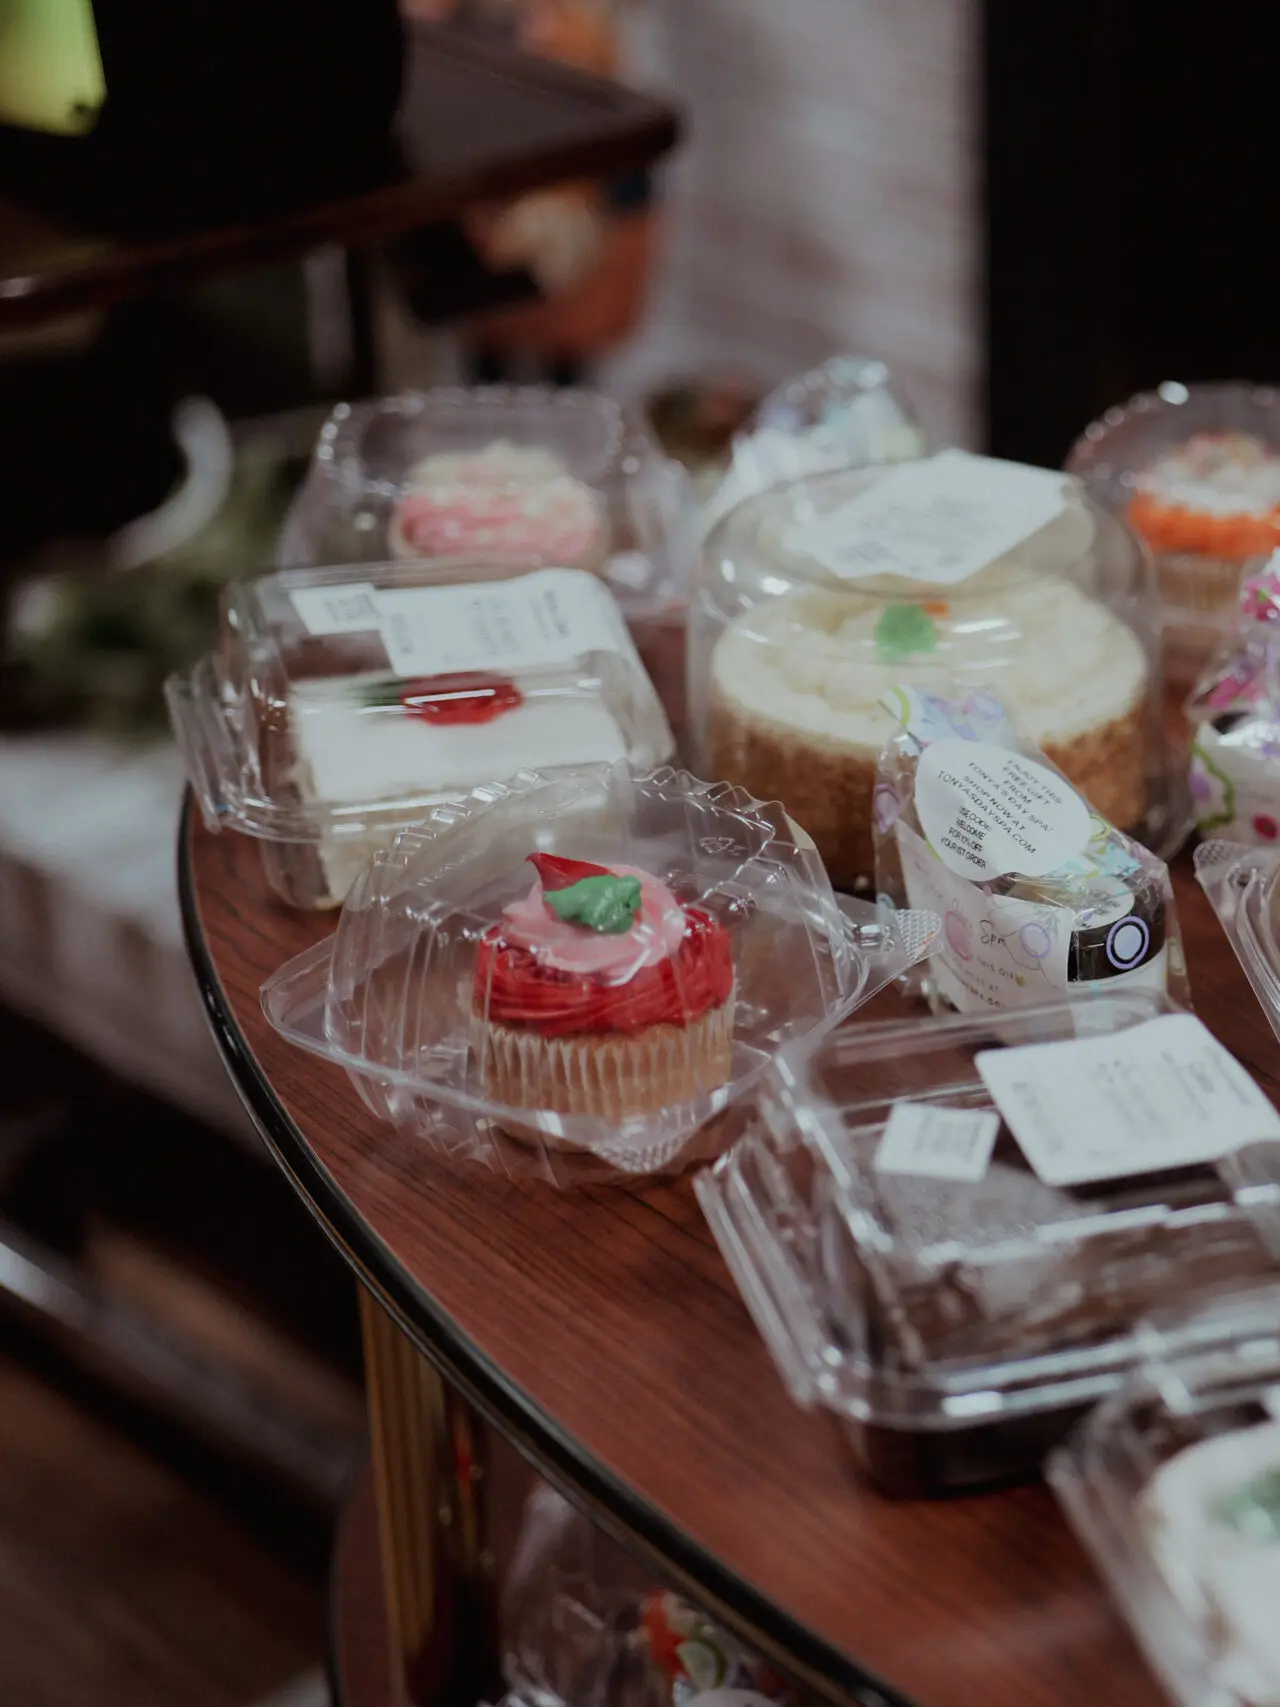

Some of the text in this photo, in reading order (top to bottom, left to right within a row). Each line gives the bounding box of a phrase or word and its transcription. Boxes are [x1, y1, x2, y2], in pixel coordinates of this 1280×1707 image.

[1003, 766, 1050, 806] FREE GIFT
[1003, 779, 1032, 804] FROM
[1042, 785, 1062, 804] THIS
[938, 770, 1036, 854] TONYASDAYSPA.COM
[963, 776, 1025, 831] SHOP NOW AT
[1008, 796, 1028, 814] DAY
[956, 817, 986, 840] WELCOME
[969, 810, 993, 832] CODE
[941, 836, 957, 851] YOUR
[965, 851, 986, 869] ORDER
[971, 839, 983, 852] OFF
